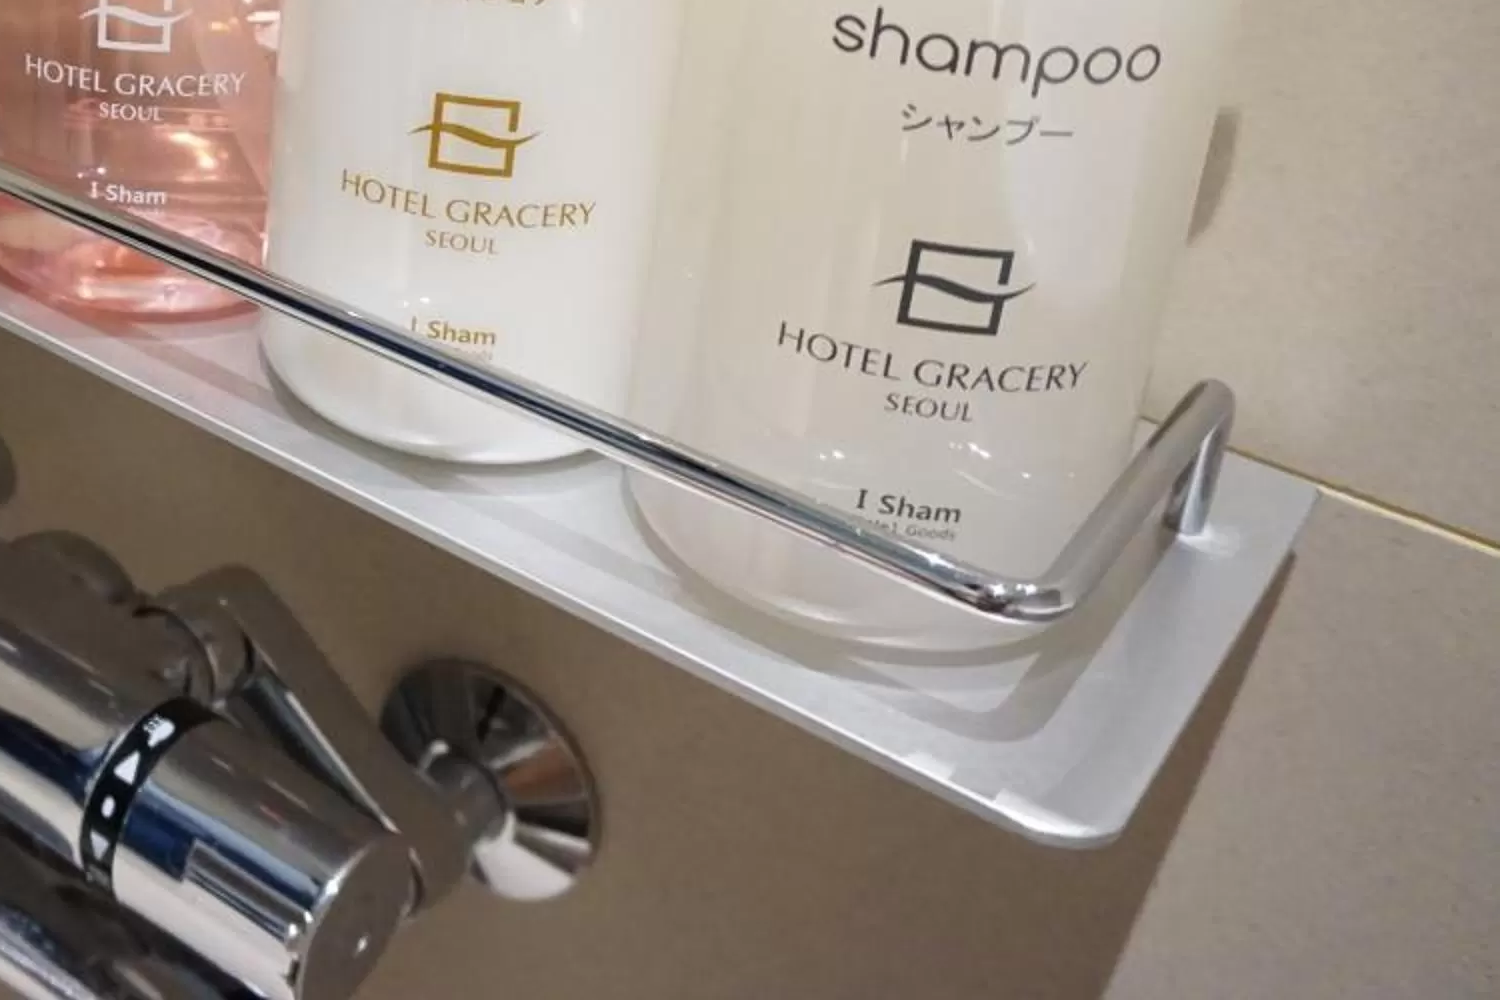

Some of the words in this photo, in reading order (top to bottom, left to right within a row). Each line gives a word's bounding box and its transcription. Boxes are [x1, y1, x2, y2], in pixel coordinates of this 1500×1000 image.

[833, 5, 1161, 99] shampoo
[25, 52, 108, 94] HOTEL
[115, 72, 246, 98] GRACERY
[99, 101, 164, 122] SEOUL
[901, 103, 1074, 146] シャンプー
[105, 184, 168, 206] Sham
[341, 168, 437, 220] HOTEL
[445, 198, 597, 230] GRACERY
[425, 229, 499, 255] SEOUL
[427, 320, 497, 345] Sham
[777, 320, 901, 382] HOTEL
[913, 358, 1090, 393] GRACERY
[884, 392, 974, 422] SEOUL
[856, 488, 868, 510] I
[878, 494, 962, 523] Sham
